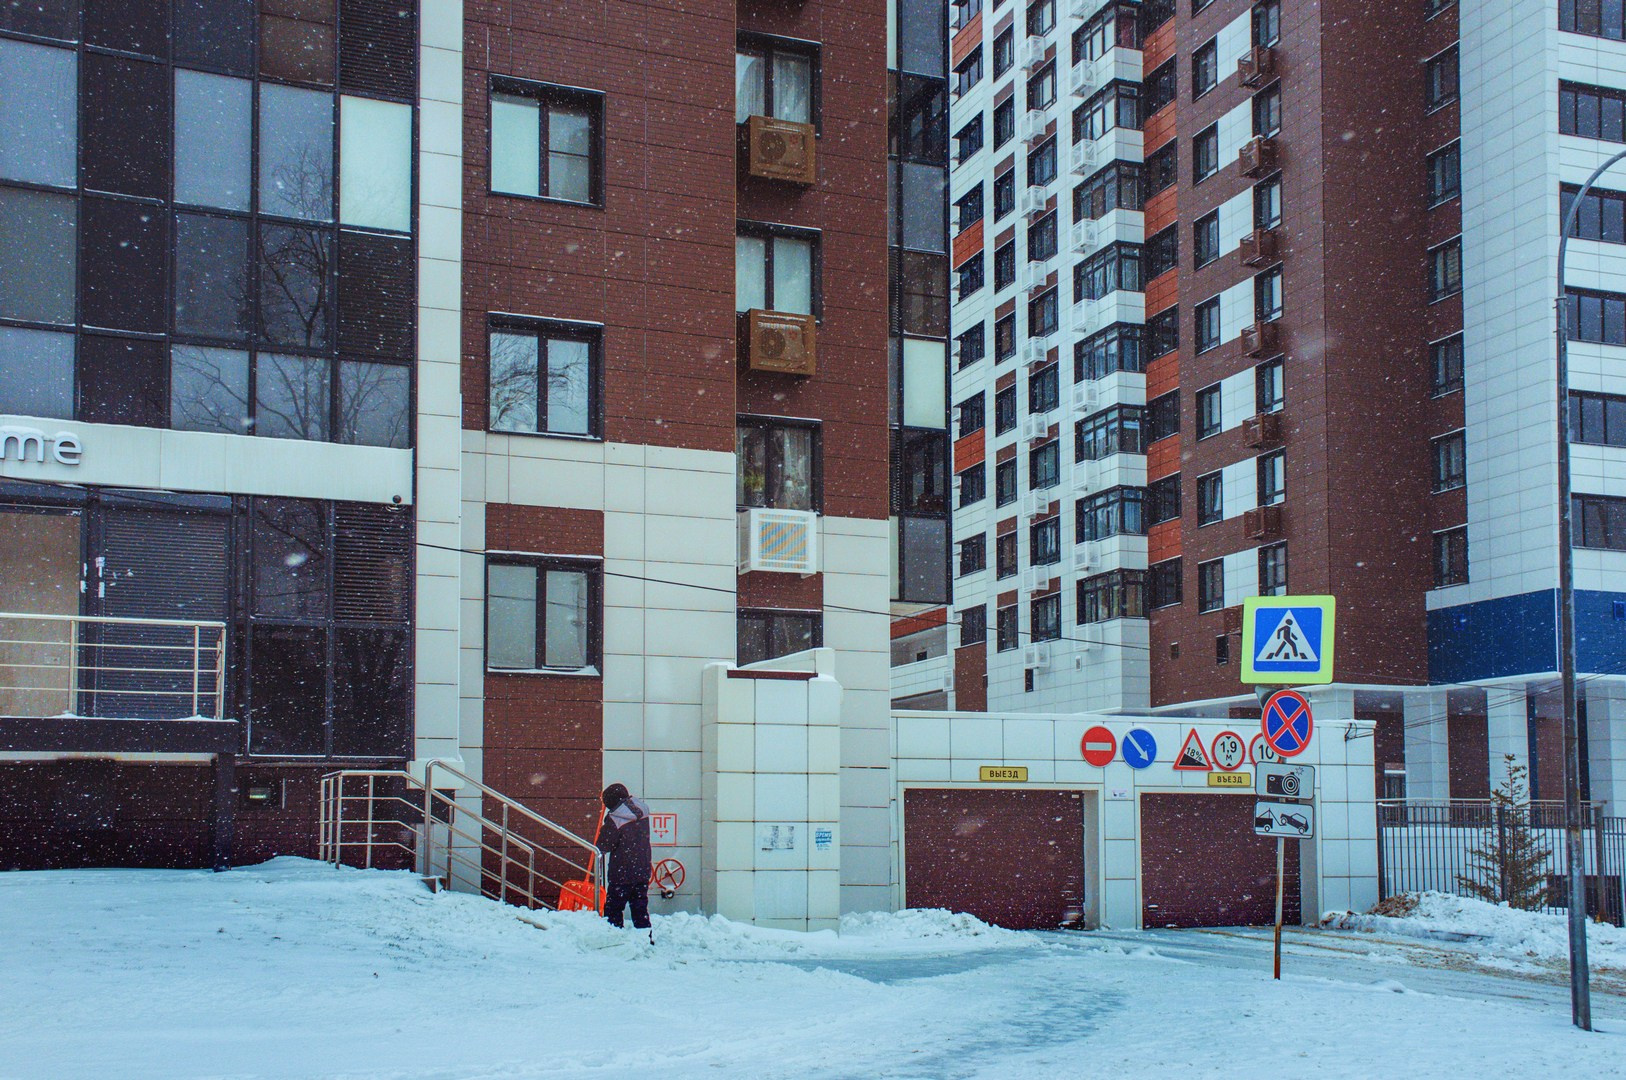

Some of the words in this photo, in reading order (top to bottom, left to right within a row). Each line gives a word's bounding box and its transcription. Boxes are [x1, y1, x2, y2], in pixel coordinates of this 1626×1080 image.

[0, 428, 82, 465] me
[1186, 747, 1203, 761] 18%
[989, 770, 1019, 779] ВЫЕЗД
[1216, 775, 1243, 784] ВЪЕЗД
[652, 816, 672, 829] ПГ
